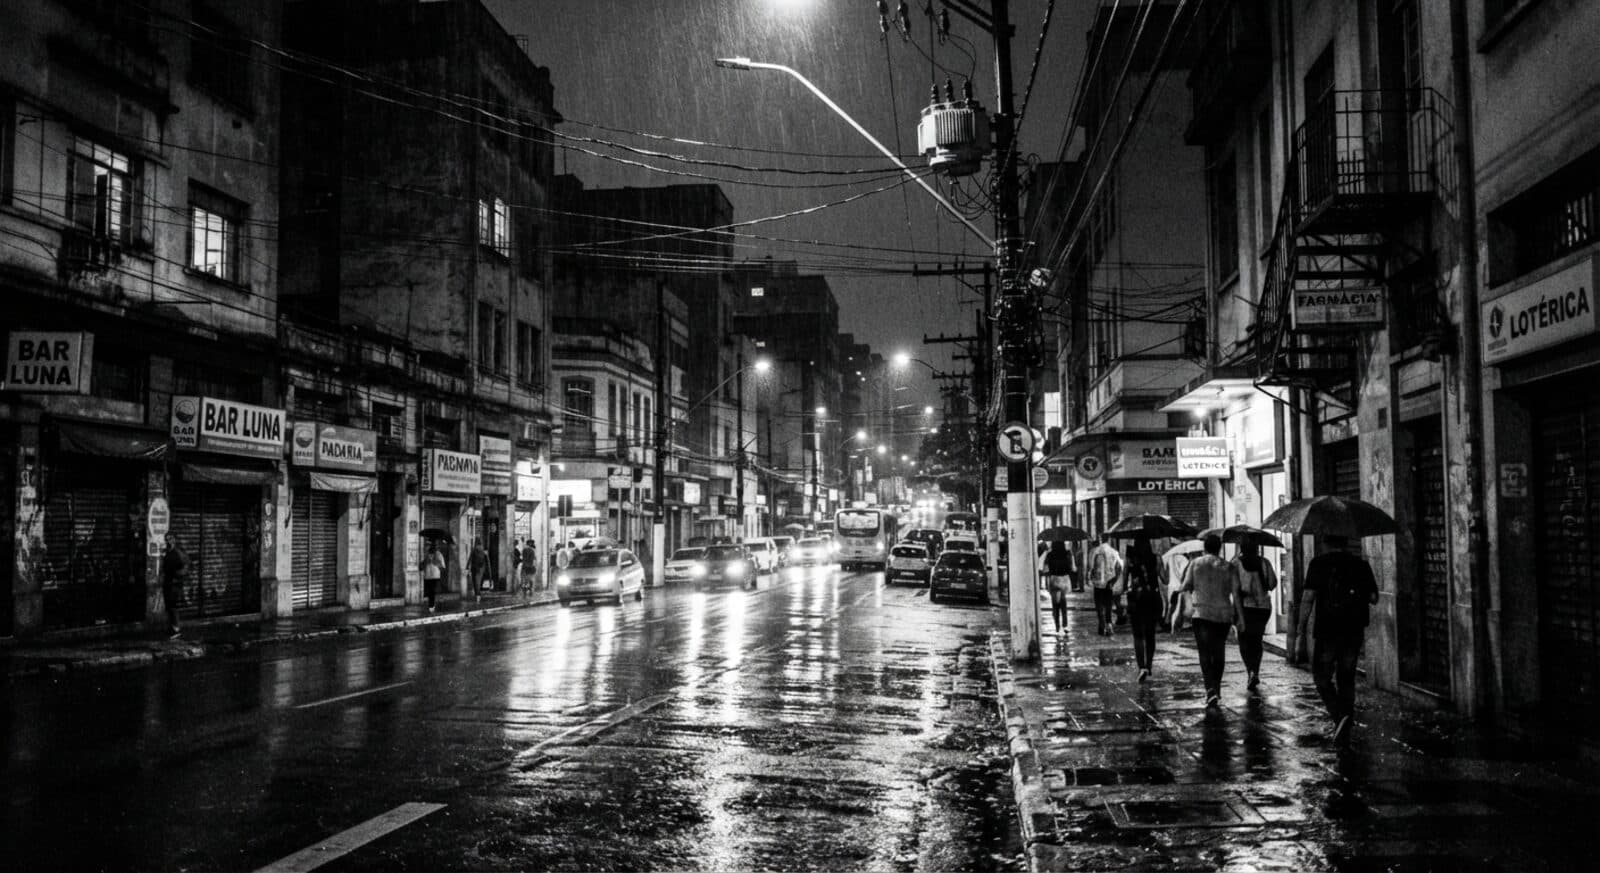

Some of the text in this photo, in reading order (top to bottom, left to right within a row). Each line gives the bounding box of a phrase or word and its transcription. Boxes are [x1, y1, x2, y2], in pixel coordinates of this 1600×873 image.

[1510, 287, 1590, 340] LOTÉRICA
[18, 340, 69, 361] BAR
[9, 365, 72, 386] LUNA
[205, 402, 280, 442] BAR LUNA
[322, 441, 362, 460] PADARIA
